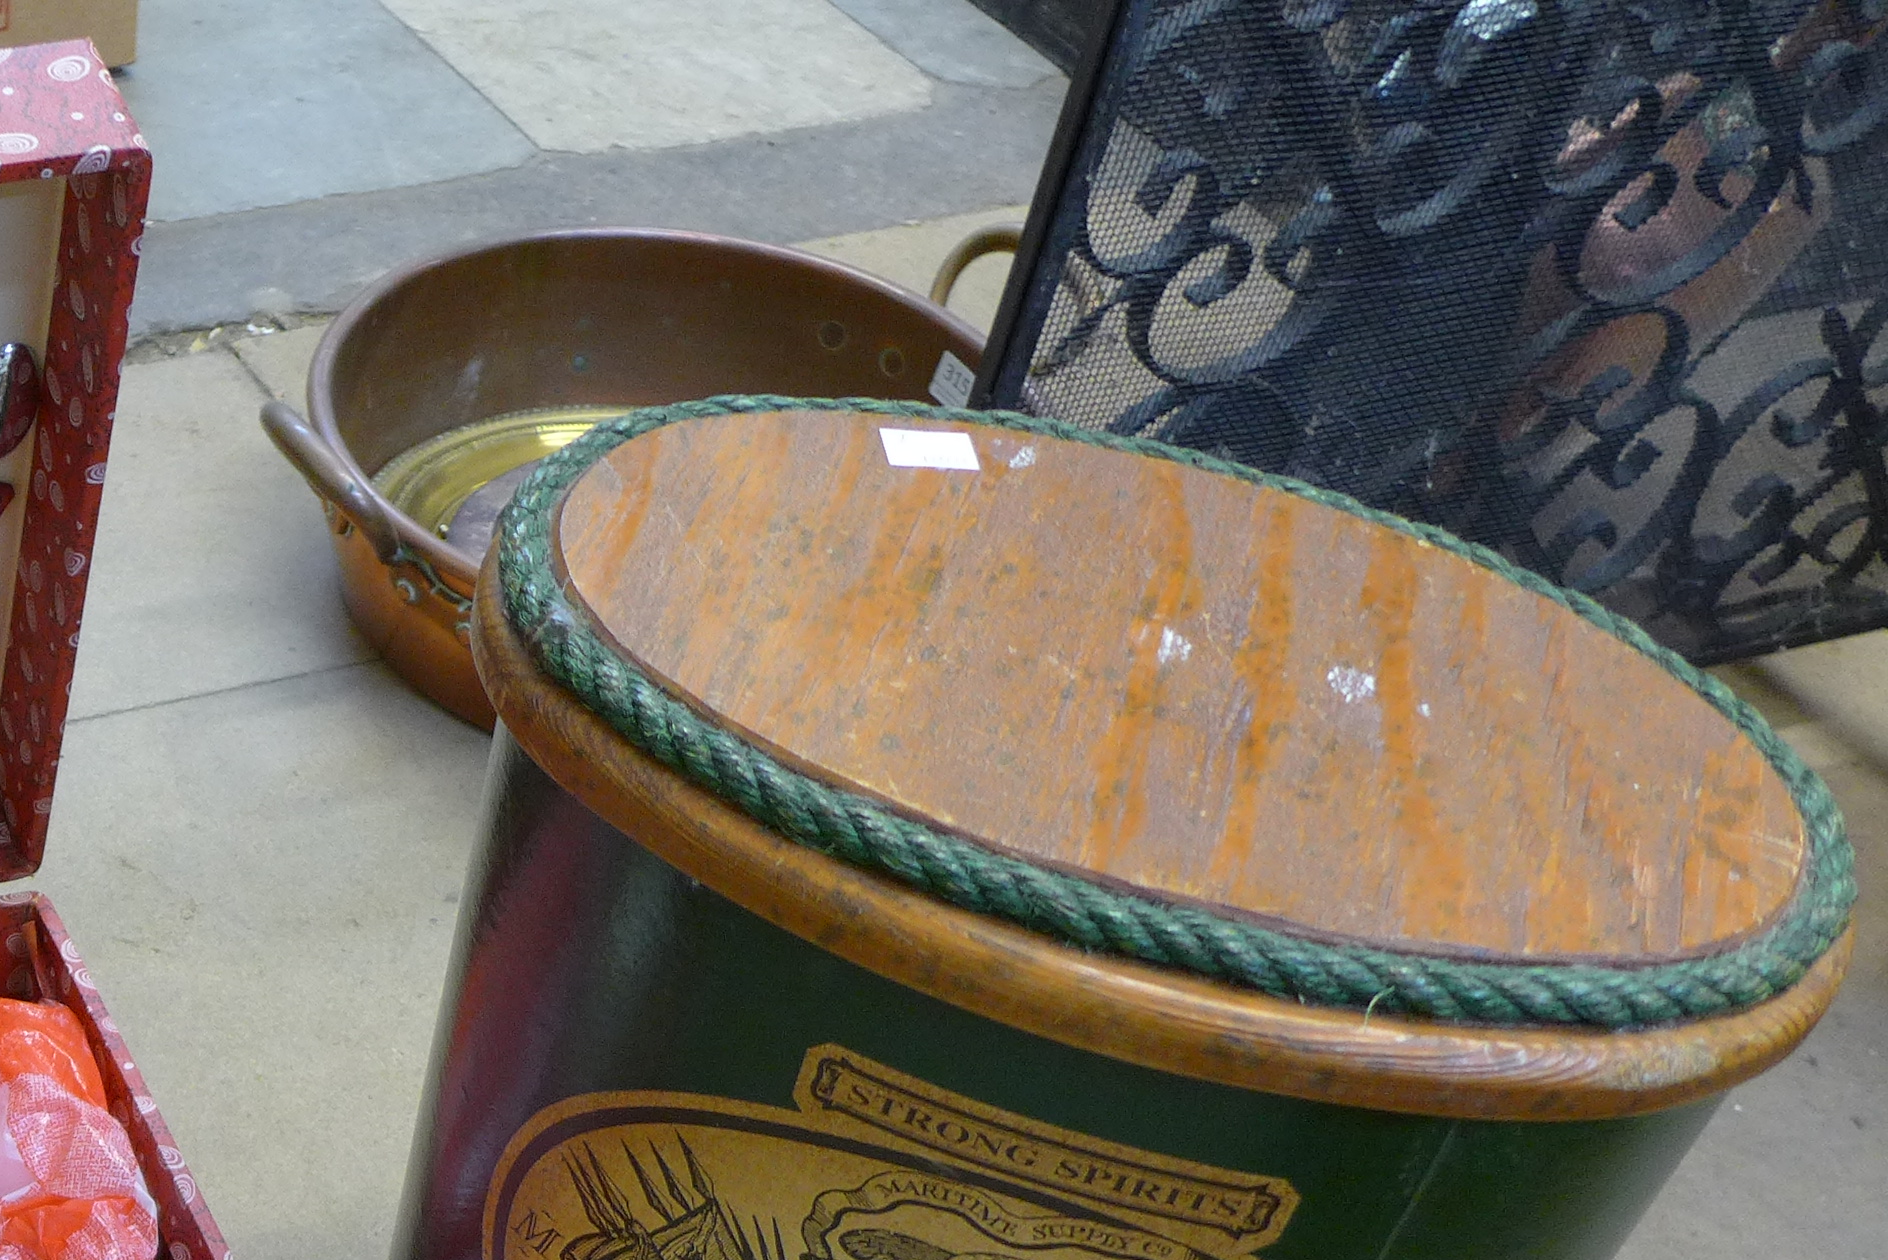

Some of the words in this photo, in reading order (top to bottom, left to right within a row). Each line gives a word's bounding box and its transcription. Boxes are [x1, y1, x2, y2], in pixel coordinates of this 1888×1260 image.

[846, 1081, 1038, 1167] STRONG
[1051, 1151, 1244, 1219] SPIRITS
[874, 1178, 1017, 1238] MARITIME
[1031, 1222, 1130, 1251] SUPPLY
